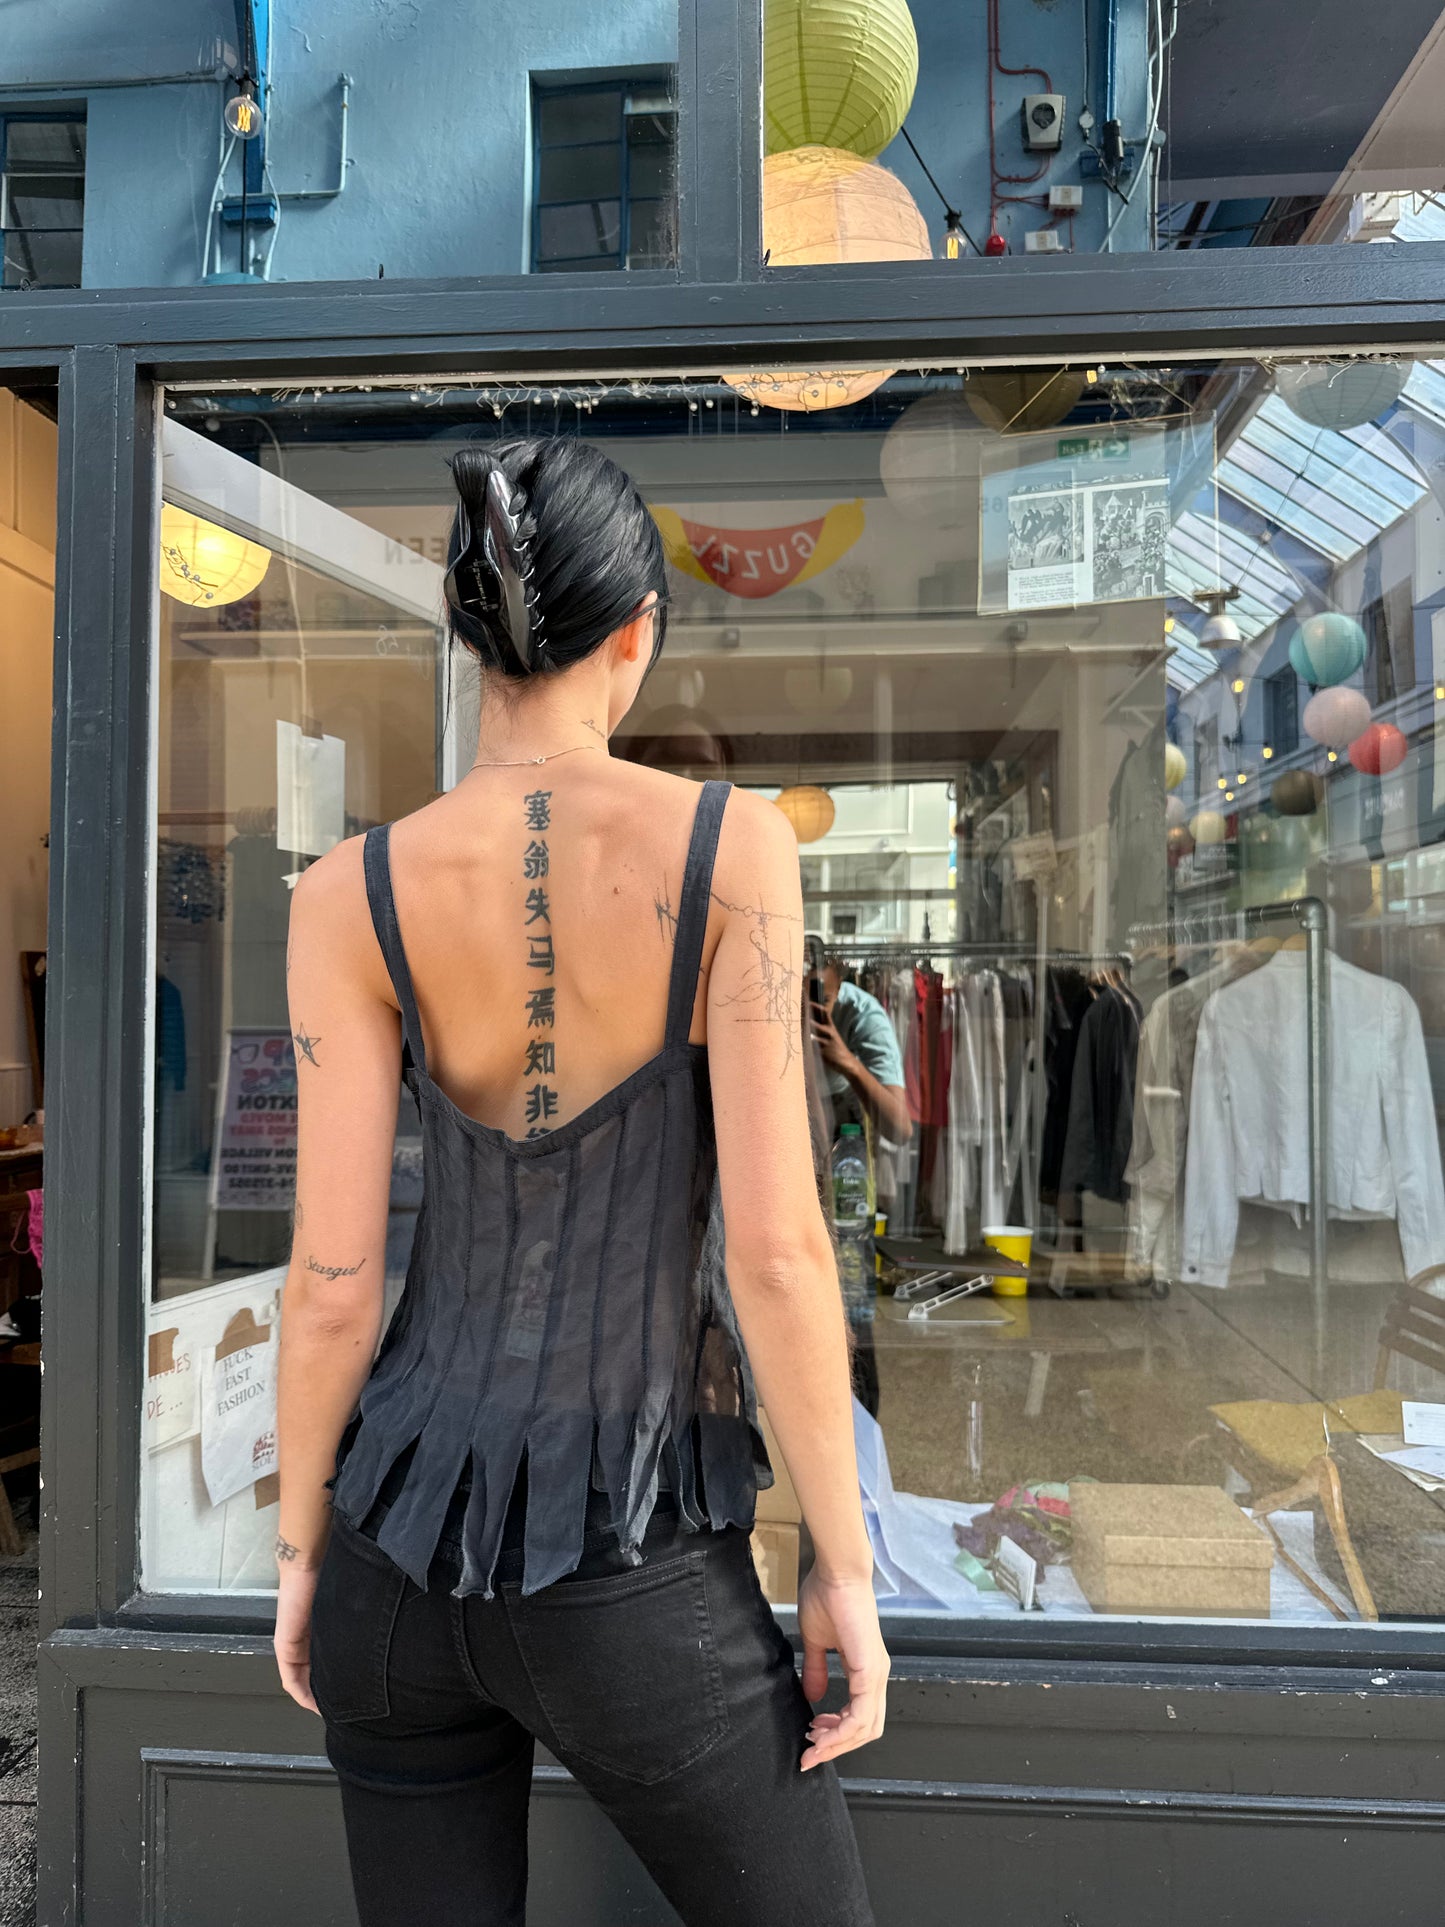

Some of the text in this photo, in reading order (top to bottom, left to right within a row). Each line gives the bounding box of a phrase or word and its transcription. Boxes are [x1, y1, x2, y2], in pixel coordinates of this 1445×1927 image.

[523, 790, 558, 1138] 塞翁失马焉知非
[225, 1367, 252, 1391] FAST
[216, 1381, 265, 1416] FASHION
